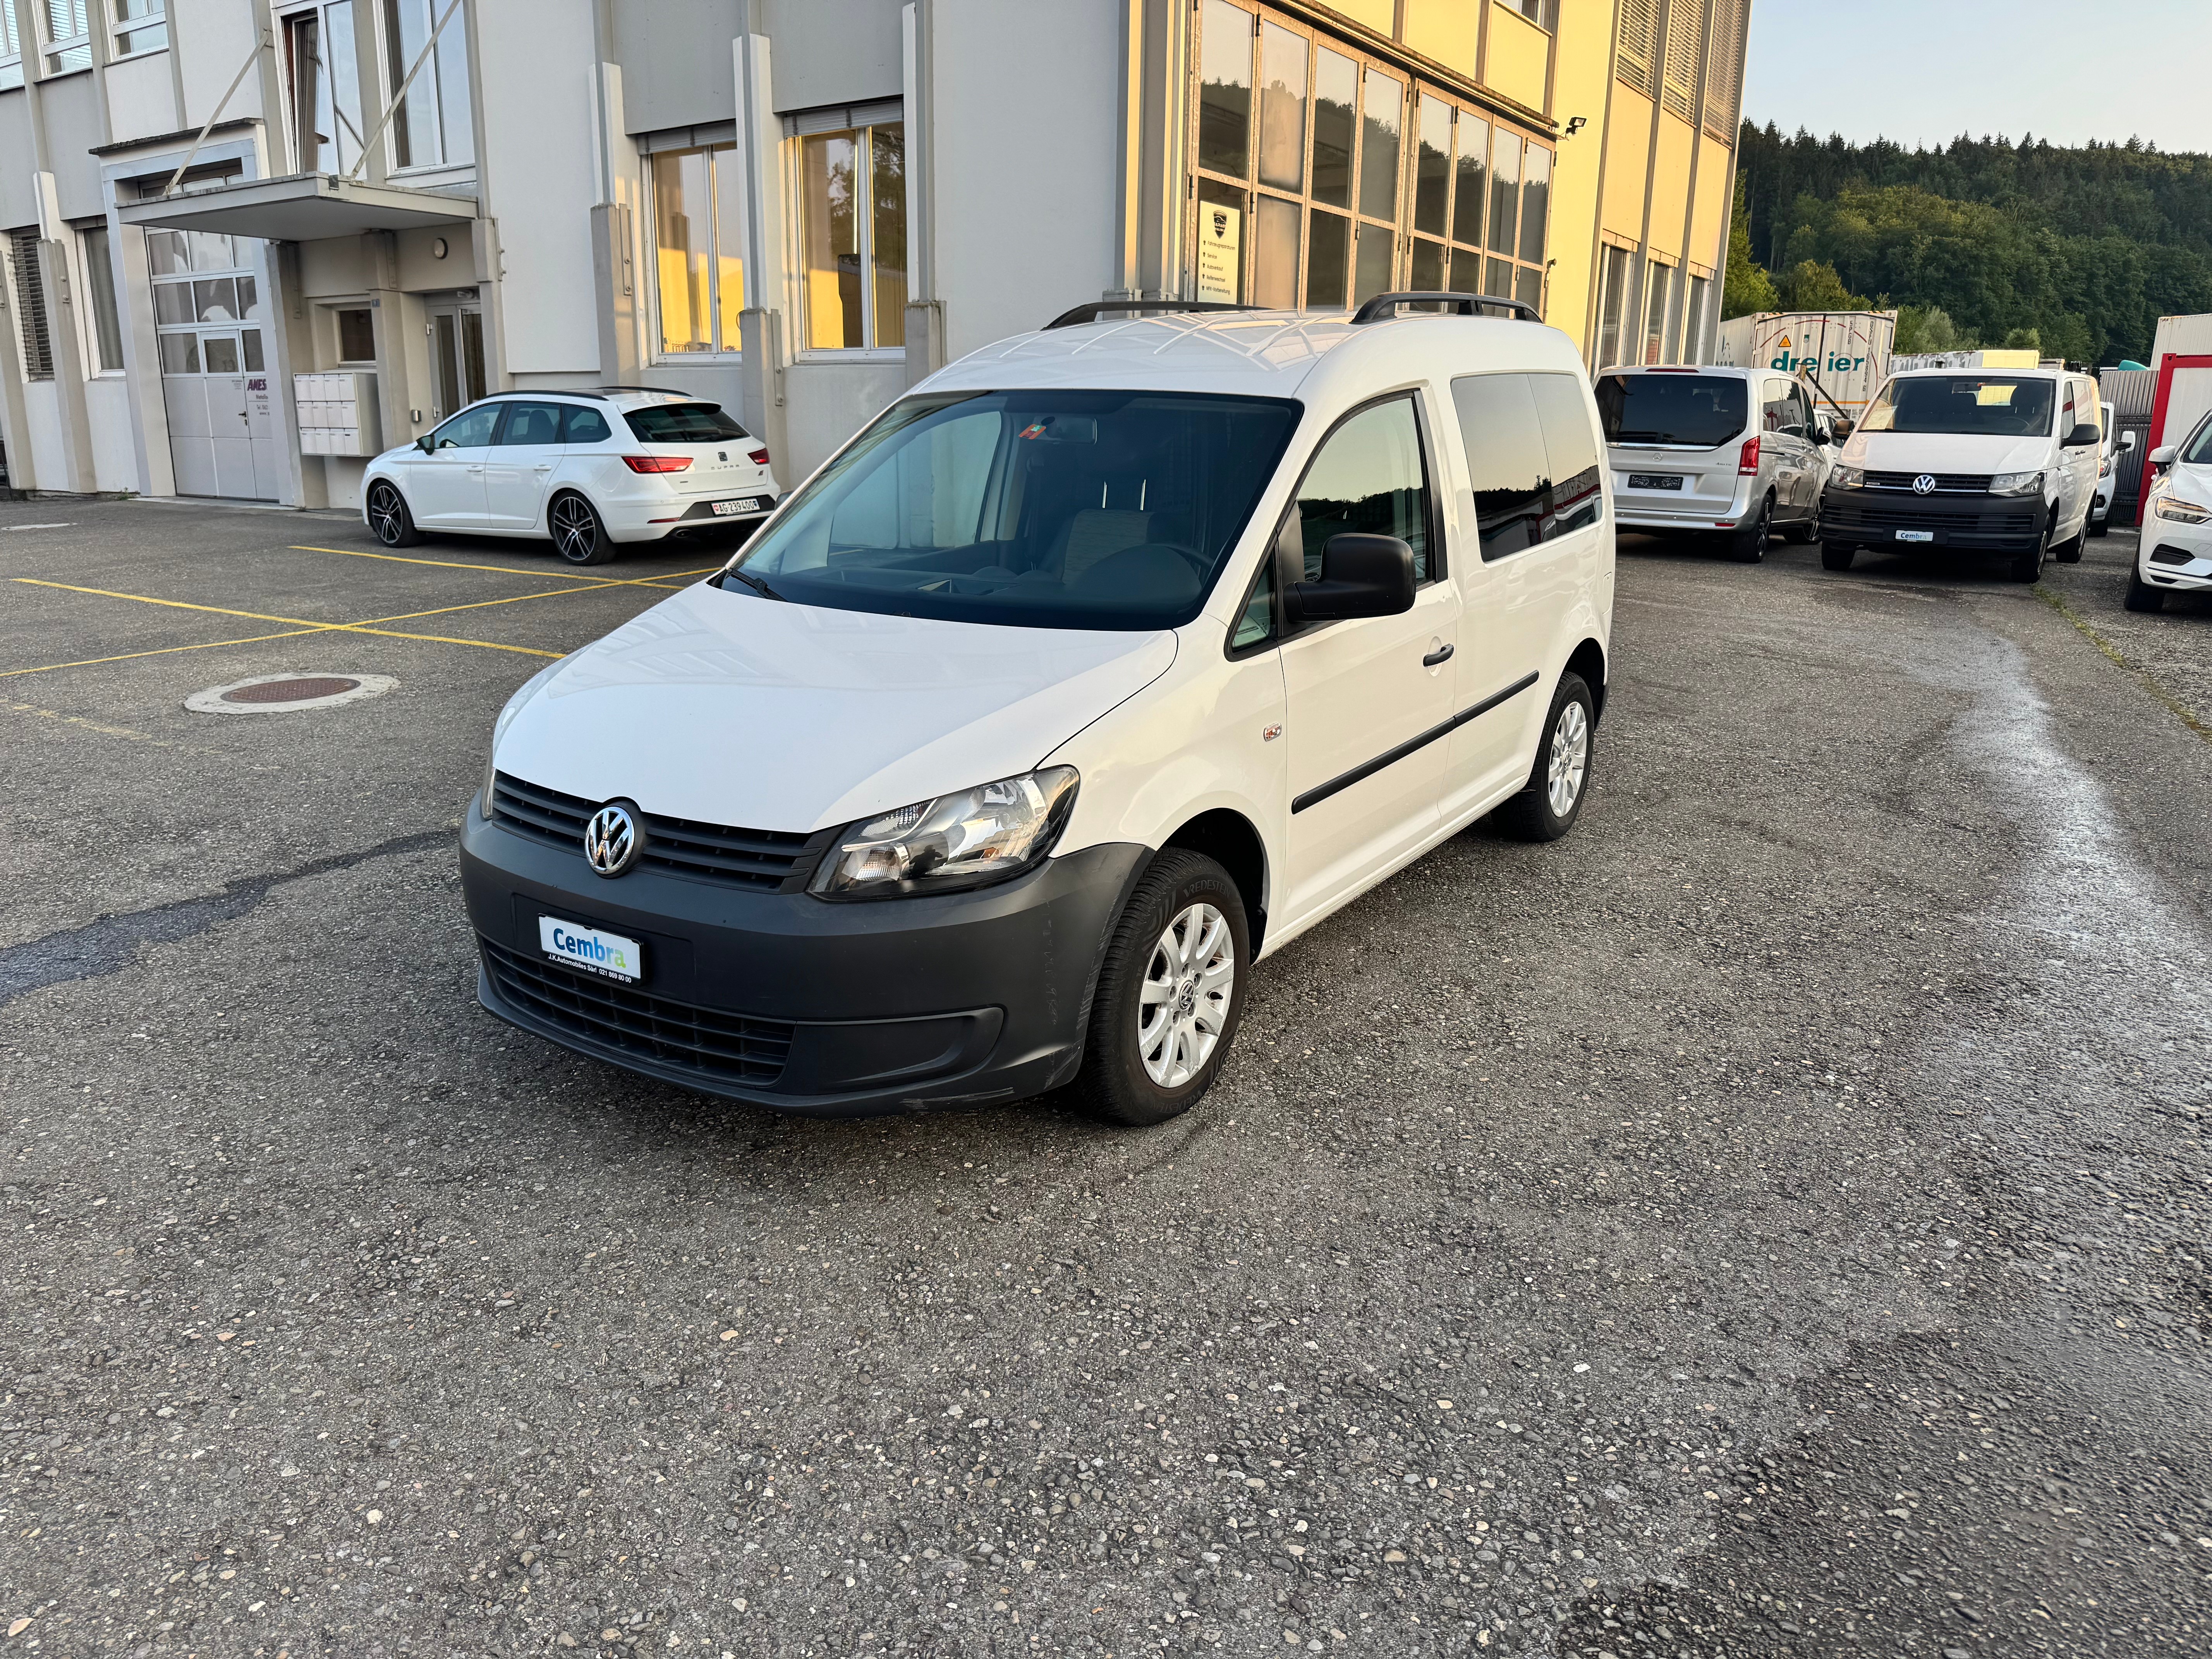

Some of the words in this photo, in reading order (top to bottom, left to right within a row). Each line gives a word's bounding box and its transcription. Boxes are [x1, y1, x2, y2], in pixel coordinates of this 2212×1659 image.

[1771, 351, 1865, 372] dreier
[1183, 879, 1231, 898] VREDESTEIN
[553, 928, 626, 969] Cembra
